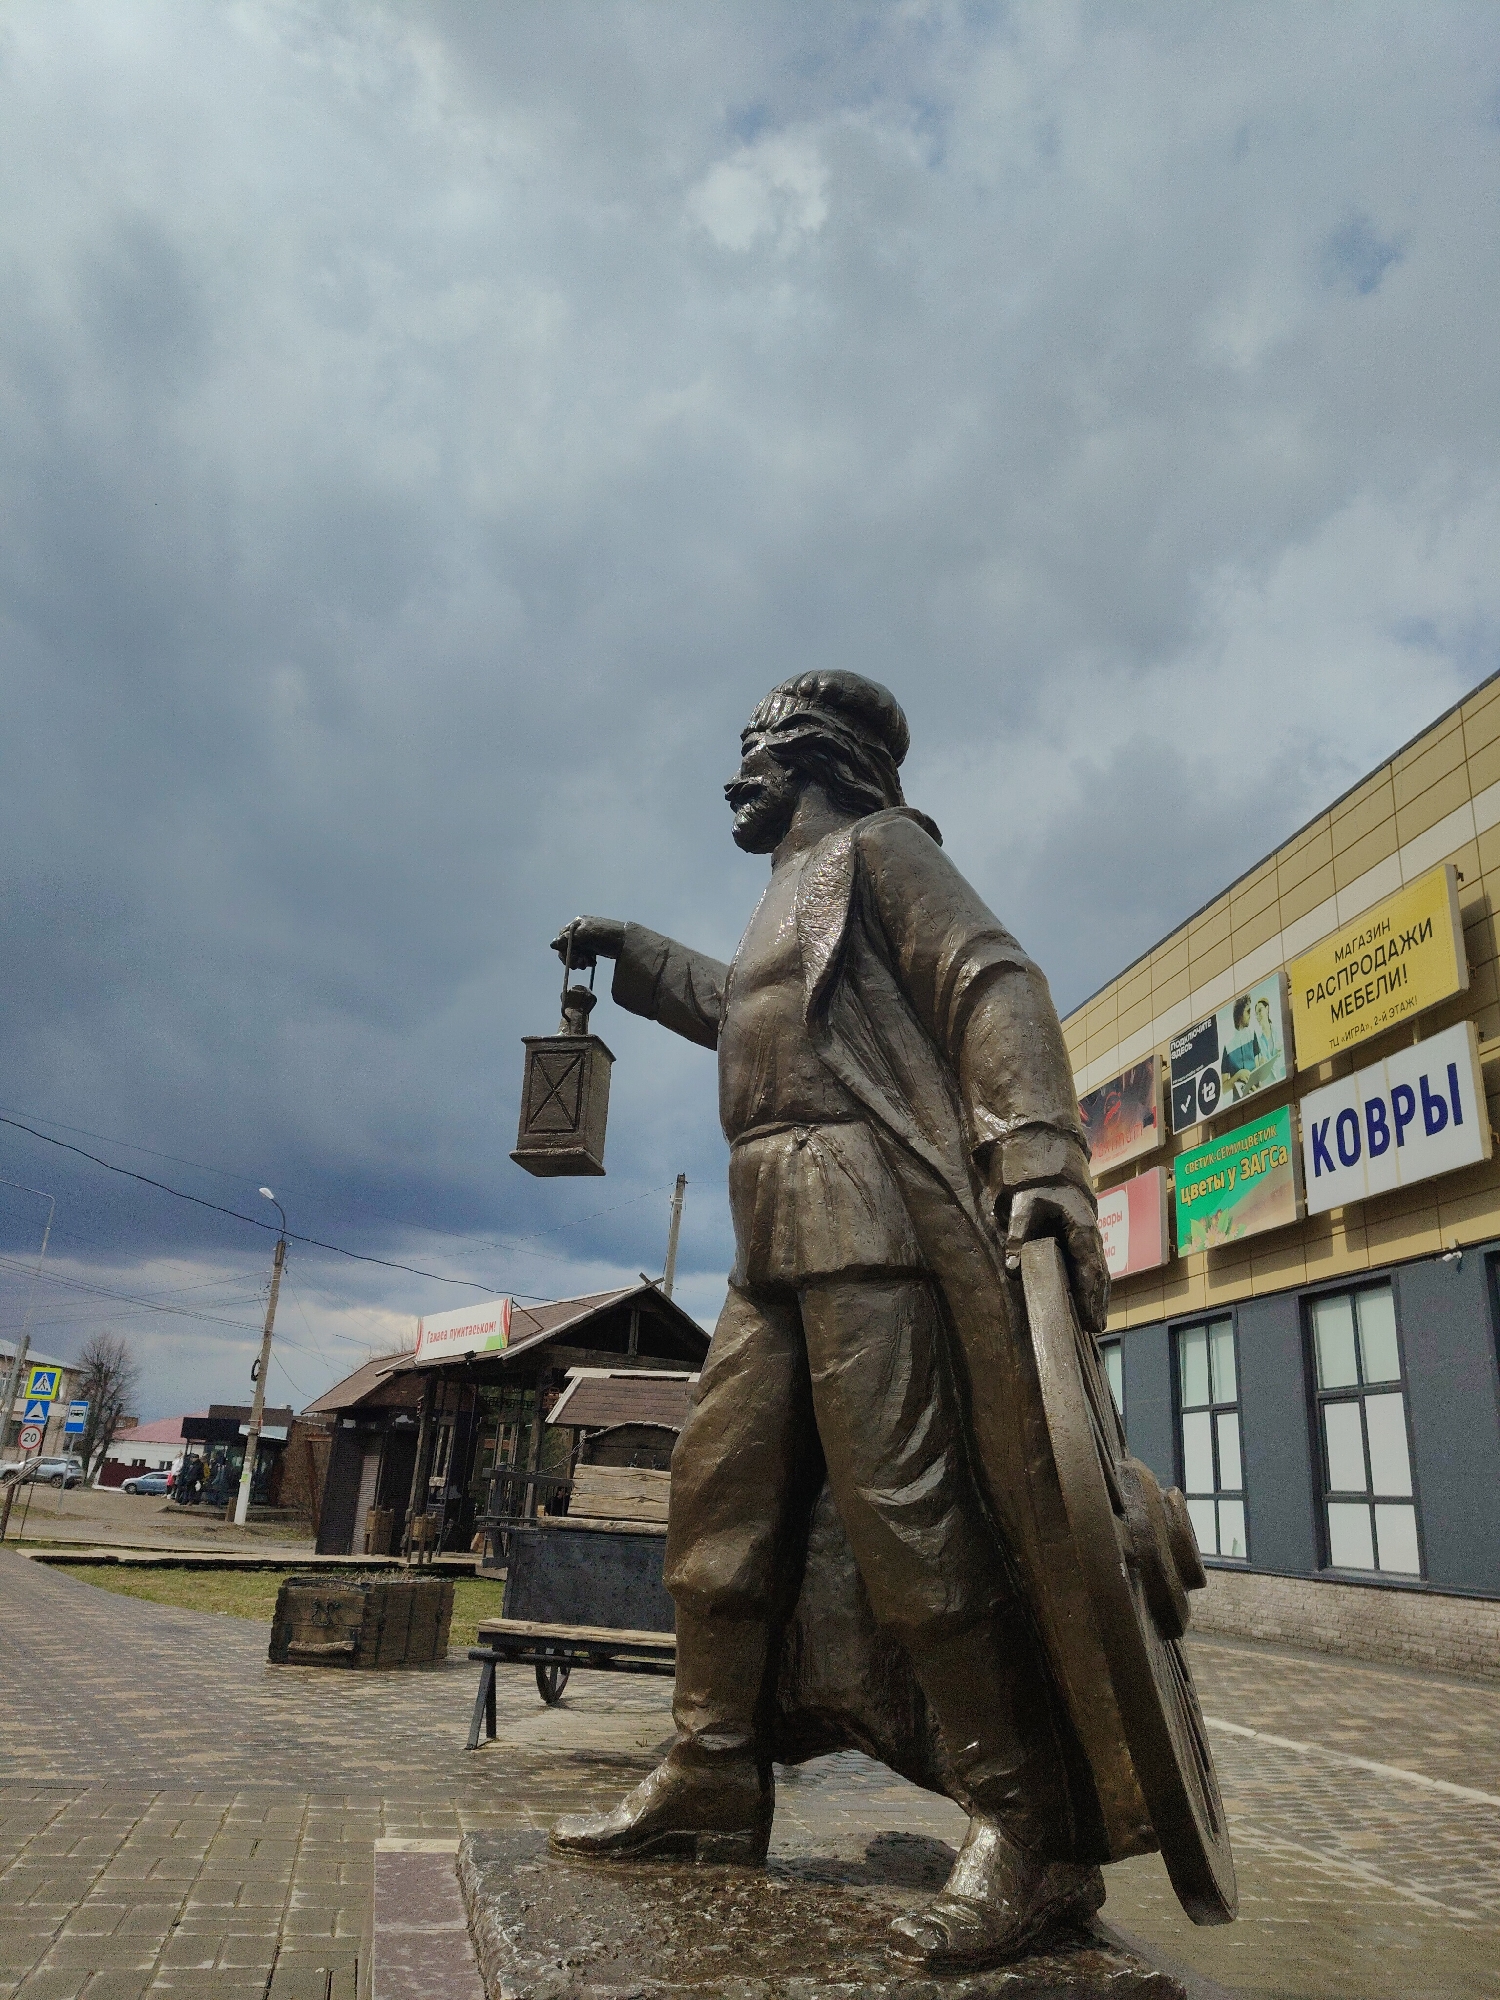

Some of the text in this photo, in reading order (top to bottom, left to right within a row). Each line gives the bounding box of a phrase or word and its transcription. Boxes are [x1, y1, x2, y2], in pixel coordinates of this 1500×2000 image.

[1334, 917, 1391, 963] МАГАЗИН
[1305, 917, 1433, 1009] РАСПРОДАЖИ
[1330, 963, 1408, 1024] МЕБЕЛИ!
[1329, 1036, 1340, 1049] ТЦ
[1341, 1023, 1373, 1043] «ИГРА»,
[1388, 995, 1418, 1019] ЭТАЖ!
[1171, 1043, 1193, 1060] ЗДЕСЬ
[1202, 1081, 1216, 1103] t2
[1311, 1062, 1464, 1178] КОВРЫ
[1240, 1145, 1289, 1181] ЗАГСа
[1097, 1210, 1122, 1229] овары
[23, 1432, 37, 1443] 20
